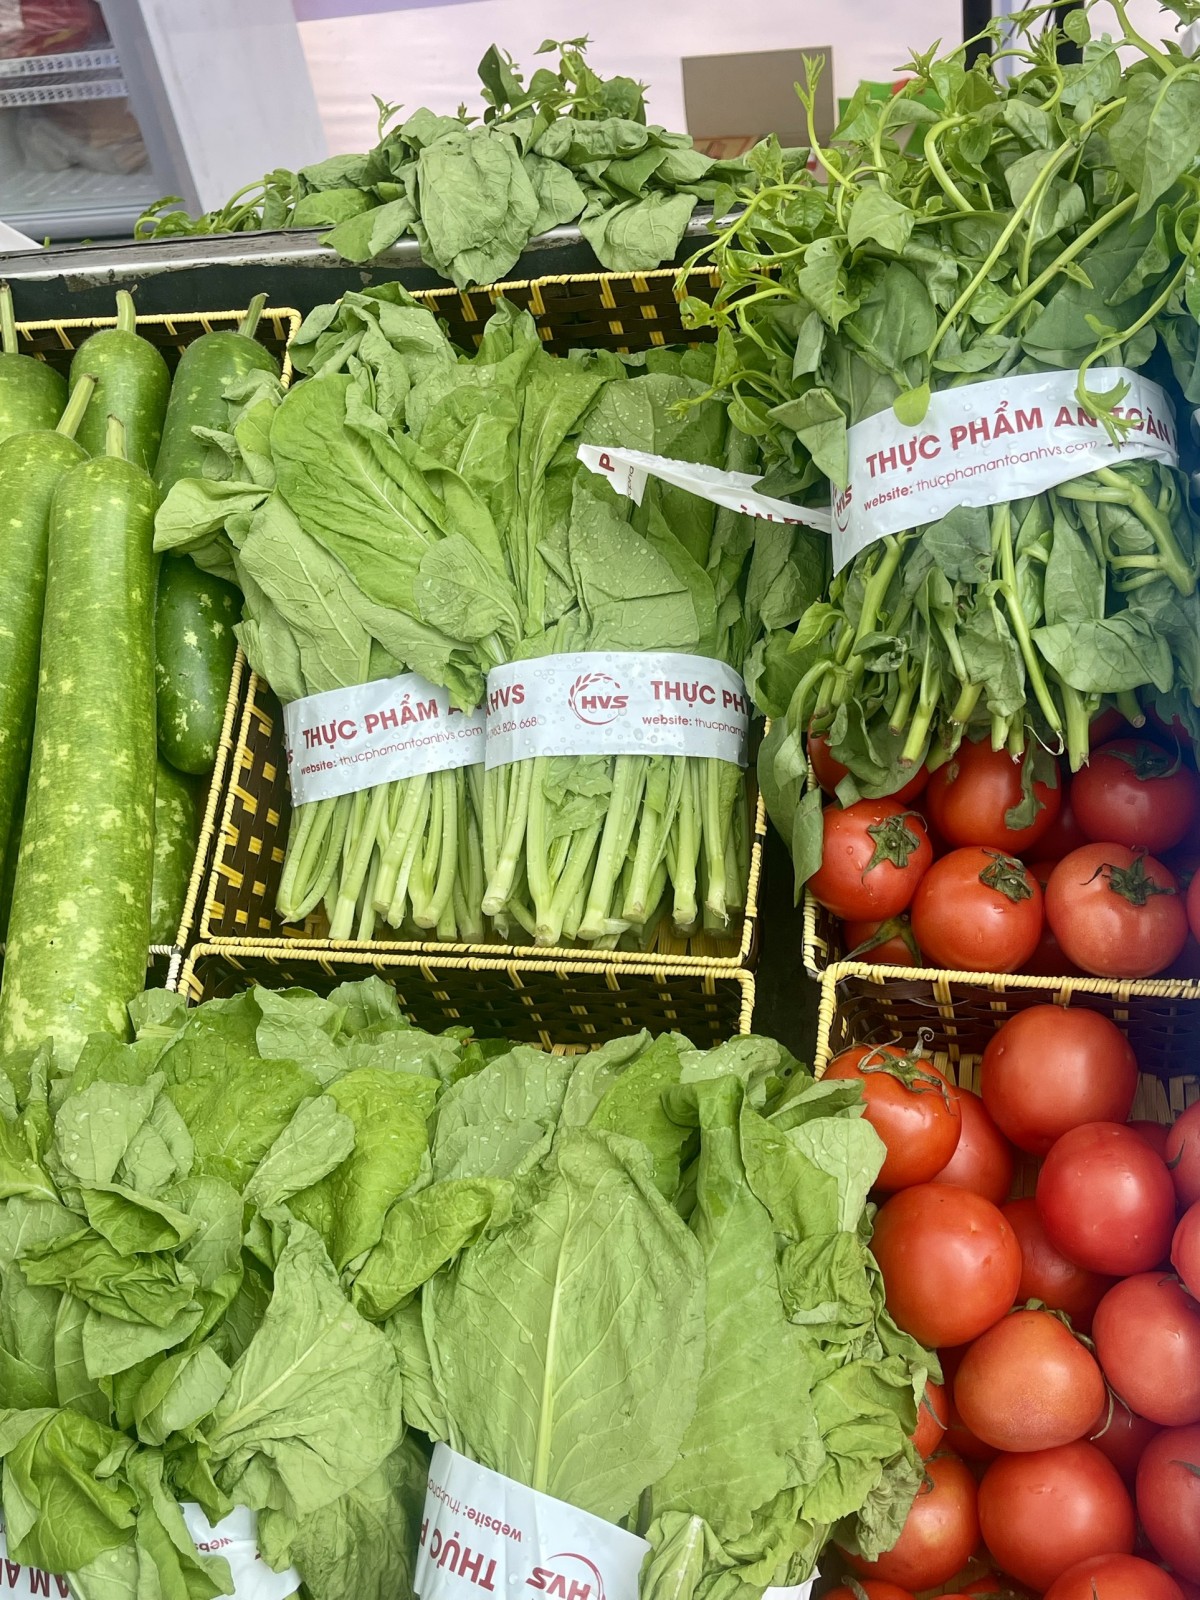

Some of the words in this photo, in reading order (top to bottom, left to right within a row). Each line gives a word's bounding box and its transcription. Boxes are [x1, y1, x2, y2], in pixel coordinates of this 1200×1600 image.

[866, 435, 942, 478] THỰC
[950, 400, 1044, 451] PHẨM
[1054, 406, 1098, 428] AN
[864, 485, 913, 511] website:
[916, 440, 1097, 492] thucphamantoanhvs.com
[490, 684, 525, 713] HVS
[581, 695, 629, 709] HVS
[650, 680, 716, 708] THỰC
[303, 719, 358, 750] THỰC
[364, 693, 439, 735] PHẨM
[642, 714, 692, 727] website:
[301, 760, 337, 776] website:
[339, 726, 483, 766] thucphamantoanhvs.com
[462, 1505, 522, 1543] website:
[430, 1528, 497, 1592] THỰC
[525, 1566, 592, 1600] HVS
